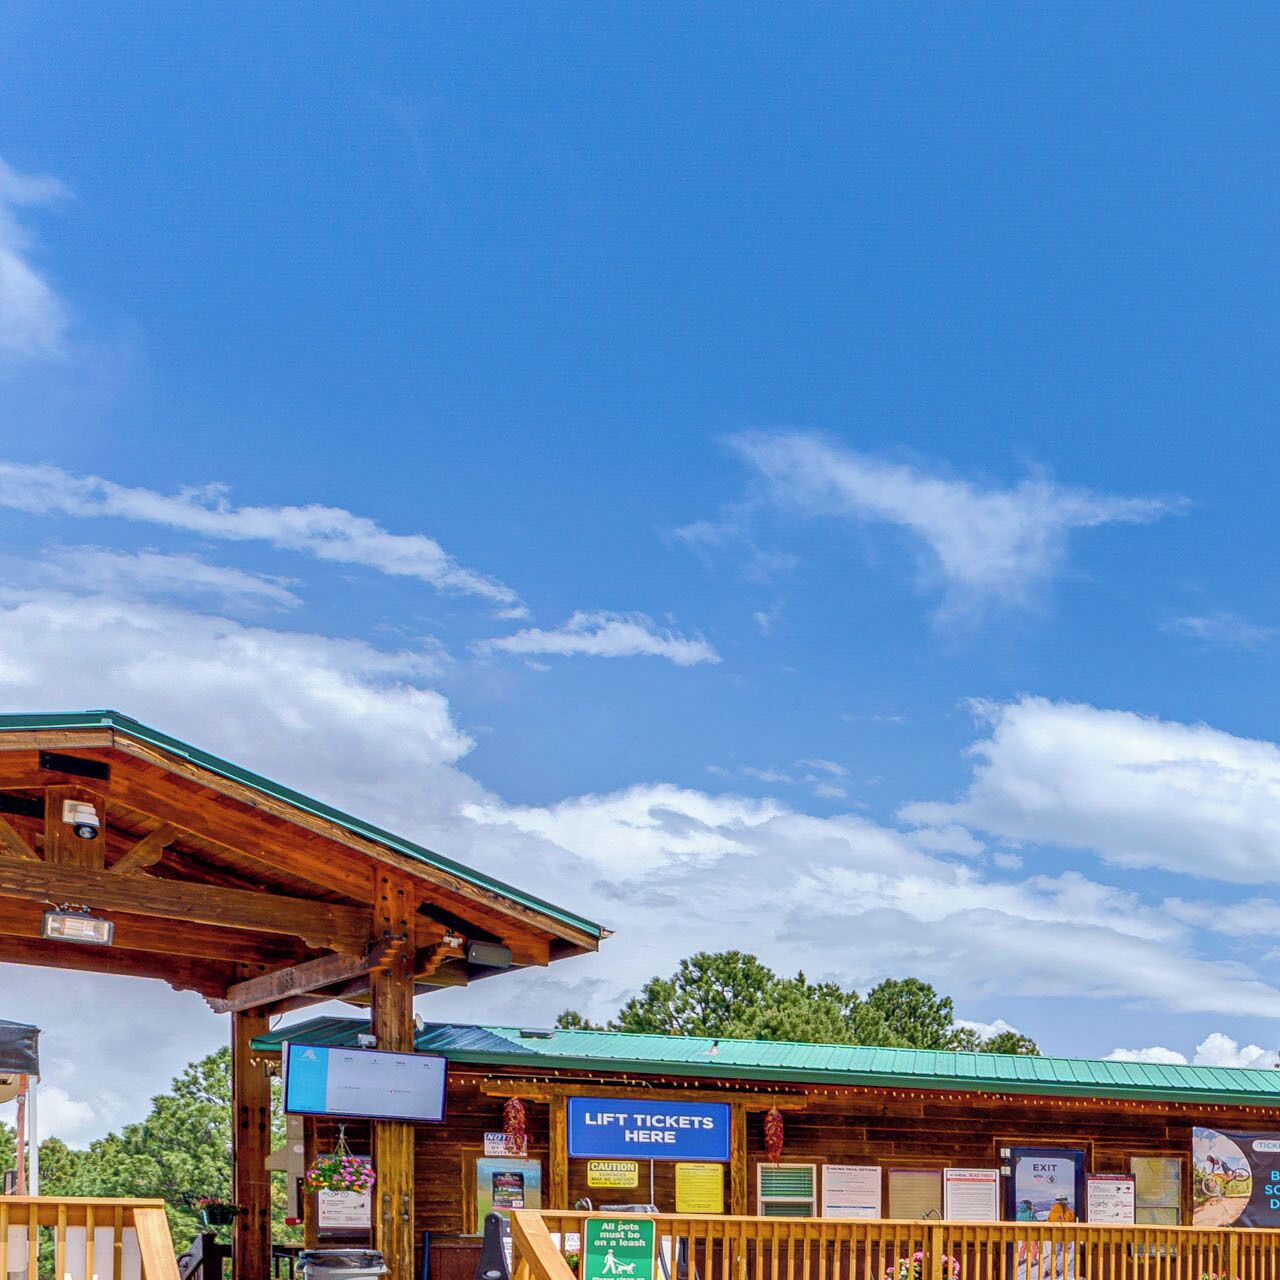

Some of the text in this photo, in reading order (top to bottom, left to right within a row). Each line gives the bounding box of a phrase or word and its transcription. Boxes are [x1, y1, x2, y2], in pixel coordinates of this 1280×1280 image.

[585, 1112, 714, 1129] LIFT TICKETS
[625, 1130, 676, 1143] HERE
[591, 1162, 635, 1171] CAUTION
[1033, 1163, 1058, 1172] EXIT
[602, 1222, 639, 1231] All pets
[628, 1231, 640, 1239] be
[619, 1239, 646, 1247] leash
